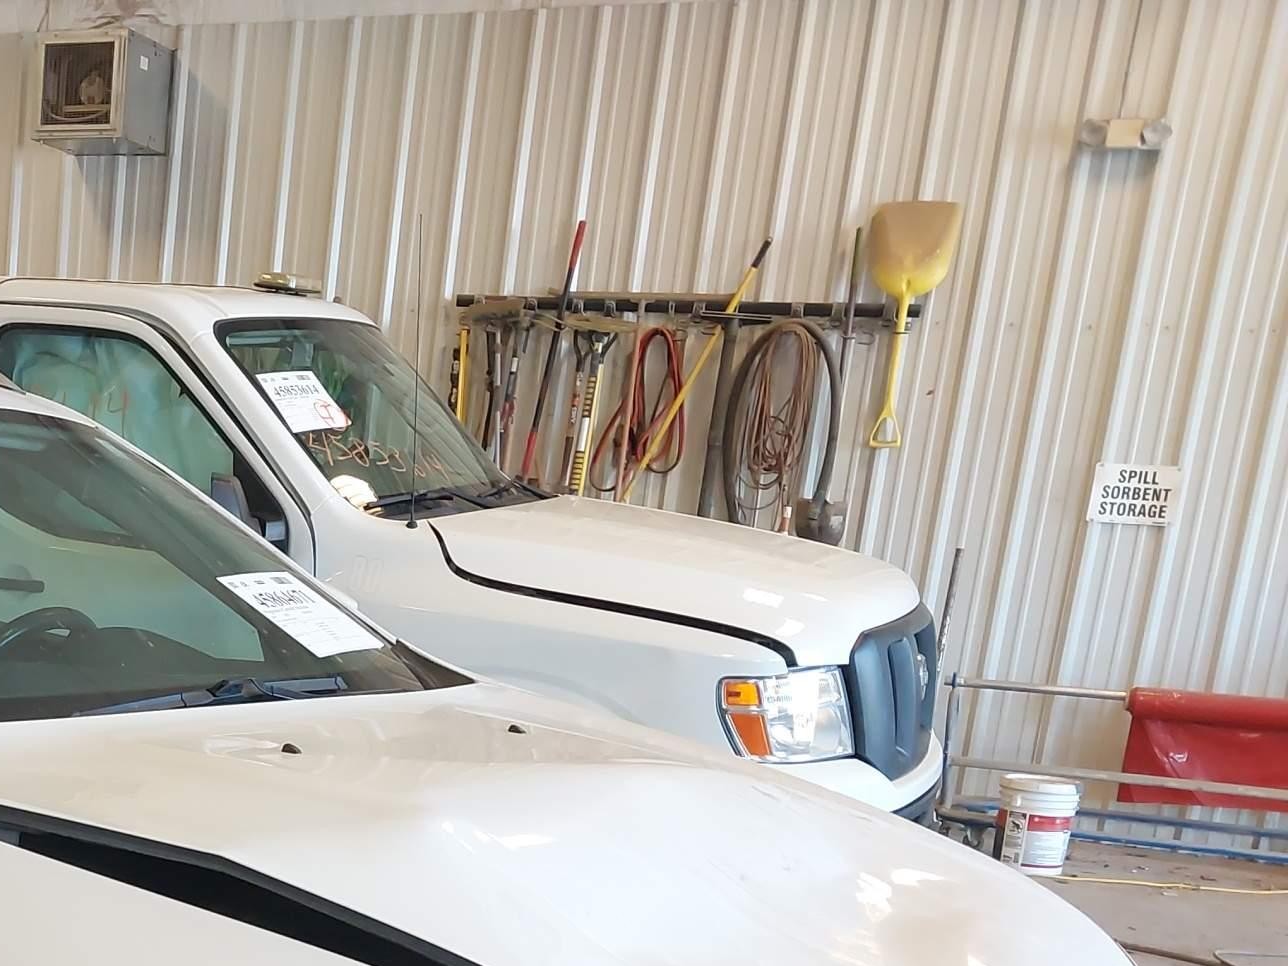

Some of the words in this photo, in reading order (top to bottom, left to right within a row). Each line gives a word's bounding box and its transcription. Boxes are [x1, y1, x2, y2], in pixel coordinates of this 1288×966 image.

[273, 384, 319, 398] 45853614
[1118, 469, 1159, 485] SPILL
[1101, 484, 1172, 503] SORBENT
[1098, 501, 1168, 519] STORAGE
[251, 589, 316, 609] 45864671
